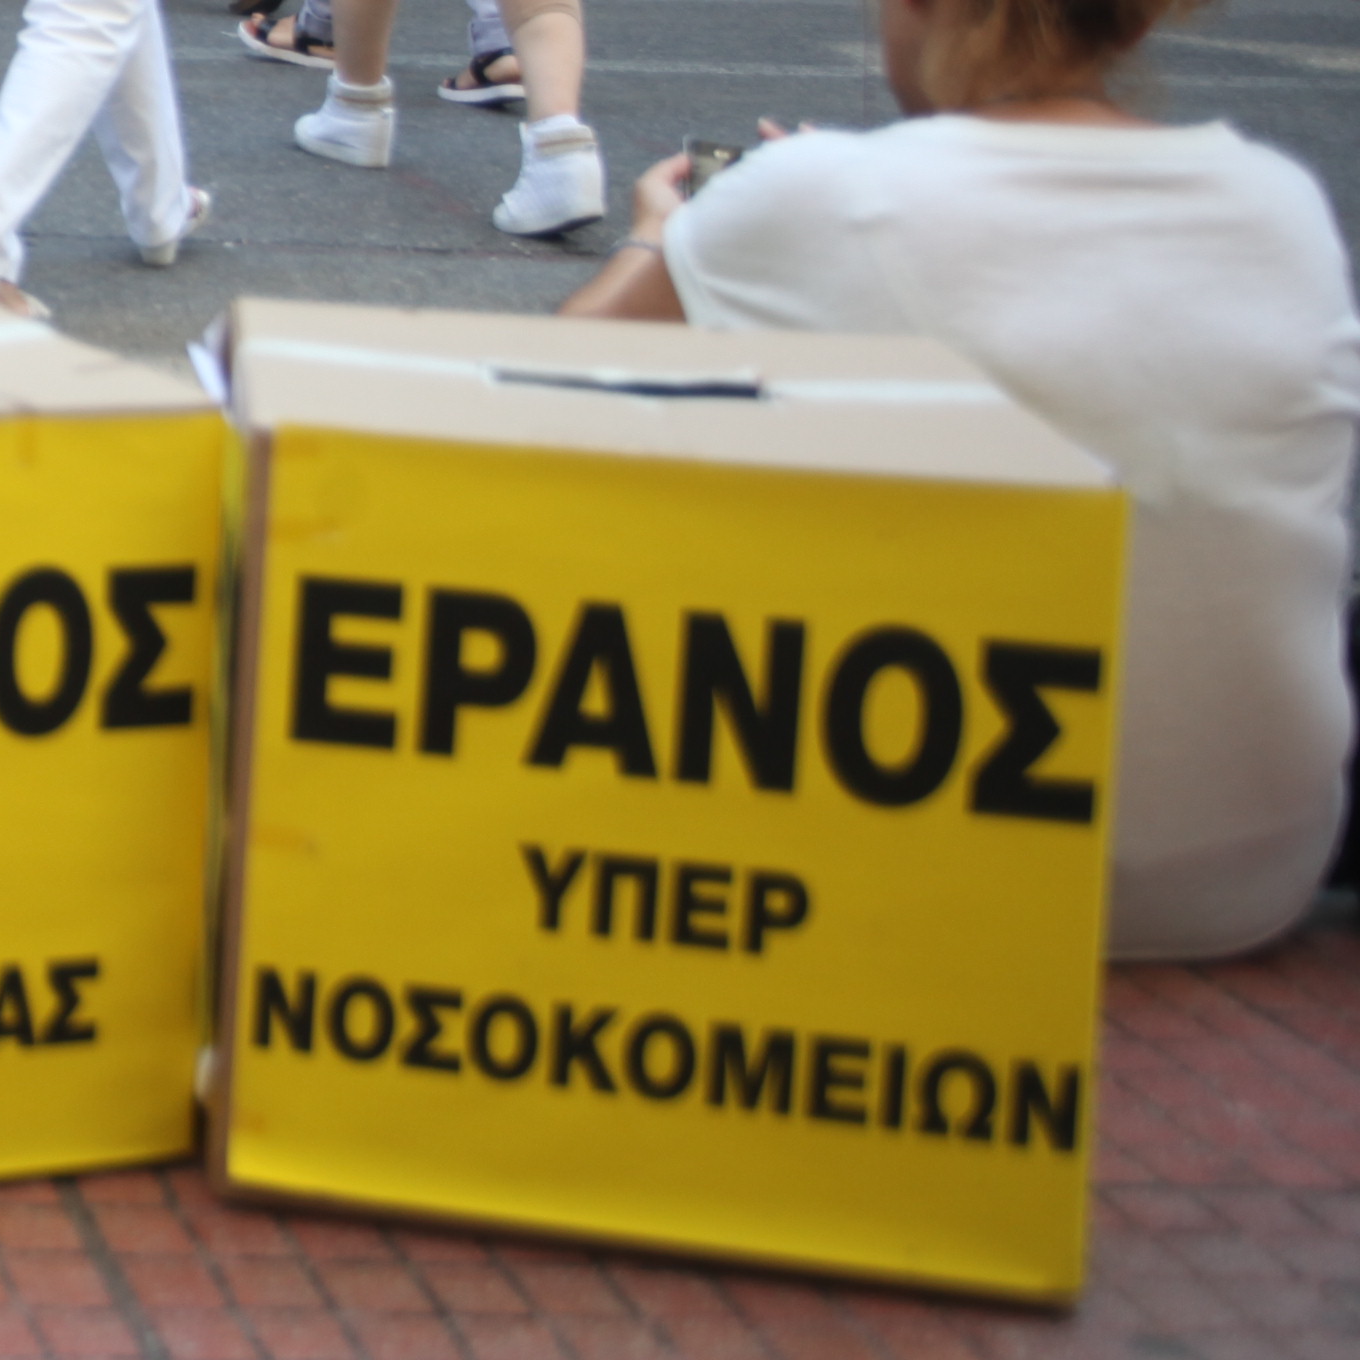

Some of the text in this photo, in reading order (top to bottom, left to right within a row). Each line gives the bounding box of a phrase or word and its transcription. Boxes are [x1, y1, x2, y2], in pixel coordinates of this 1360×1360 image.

[290, 576, 1103, 827] ΕΡΑΝΟΣ
[522, 847, 811, 956] ΥΠΕΡ
[252, 968, 1078, 1153] ΝΟΣΟΚΟΜΕΙΩΝ
